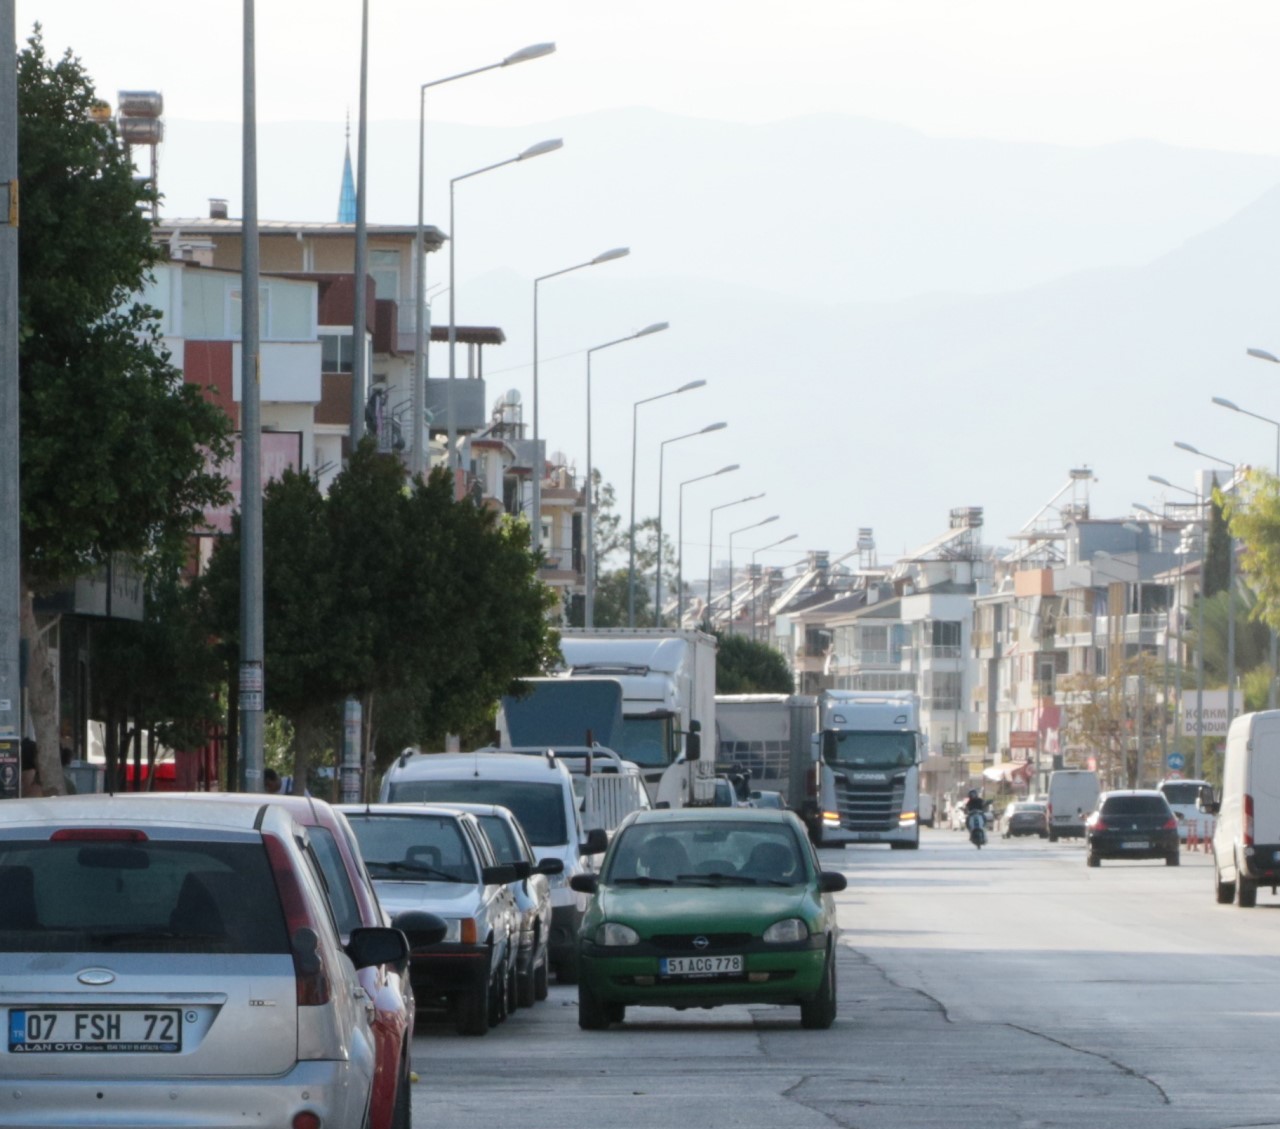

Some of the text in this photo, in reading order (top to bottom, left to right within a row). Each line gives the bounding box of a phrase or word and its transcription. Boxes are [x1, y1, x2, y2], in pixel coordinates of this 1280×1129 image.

[668, 956, 740, 972] 51 ACG 778
[27, 1013, 174, 1041] 07 FSH 72
[13, 1043, 52, 1051] ALAN
[54, 1043, 84, 1051] OTO
